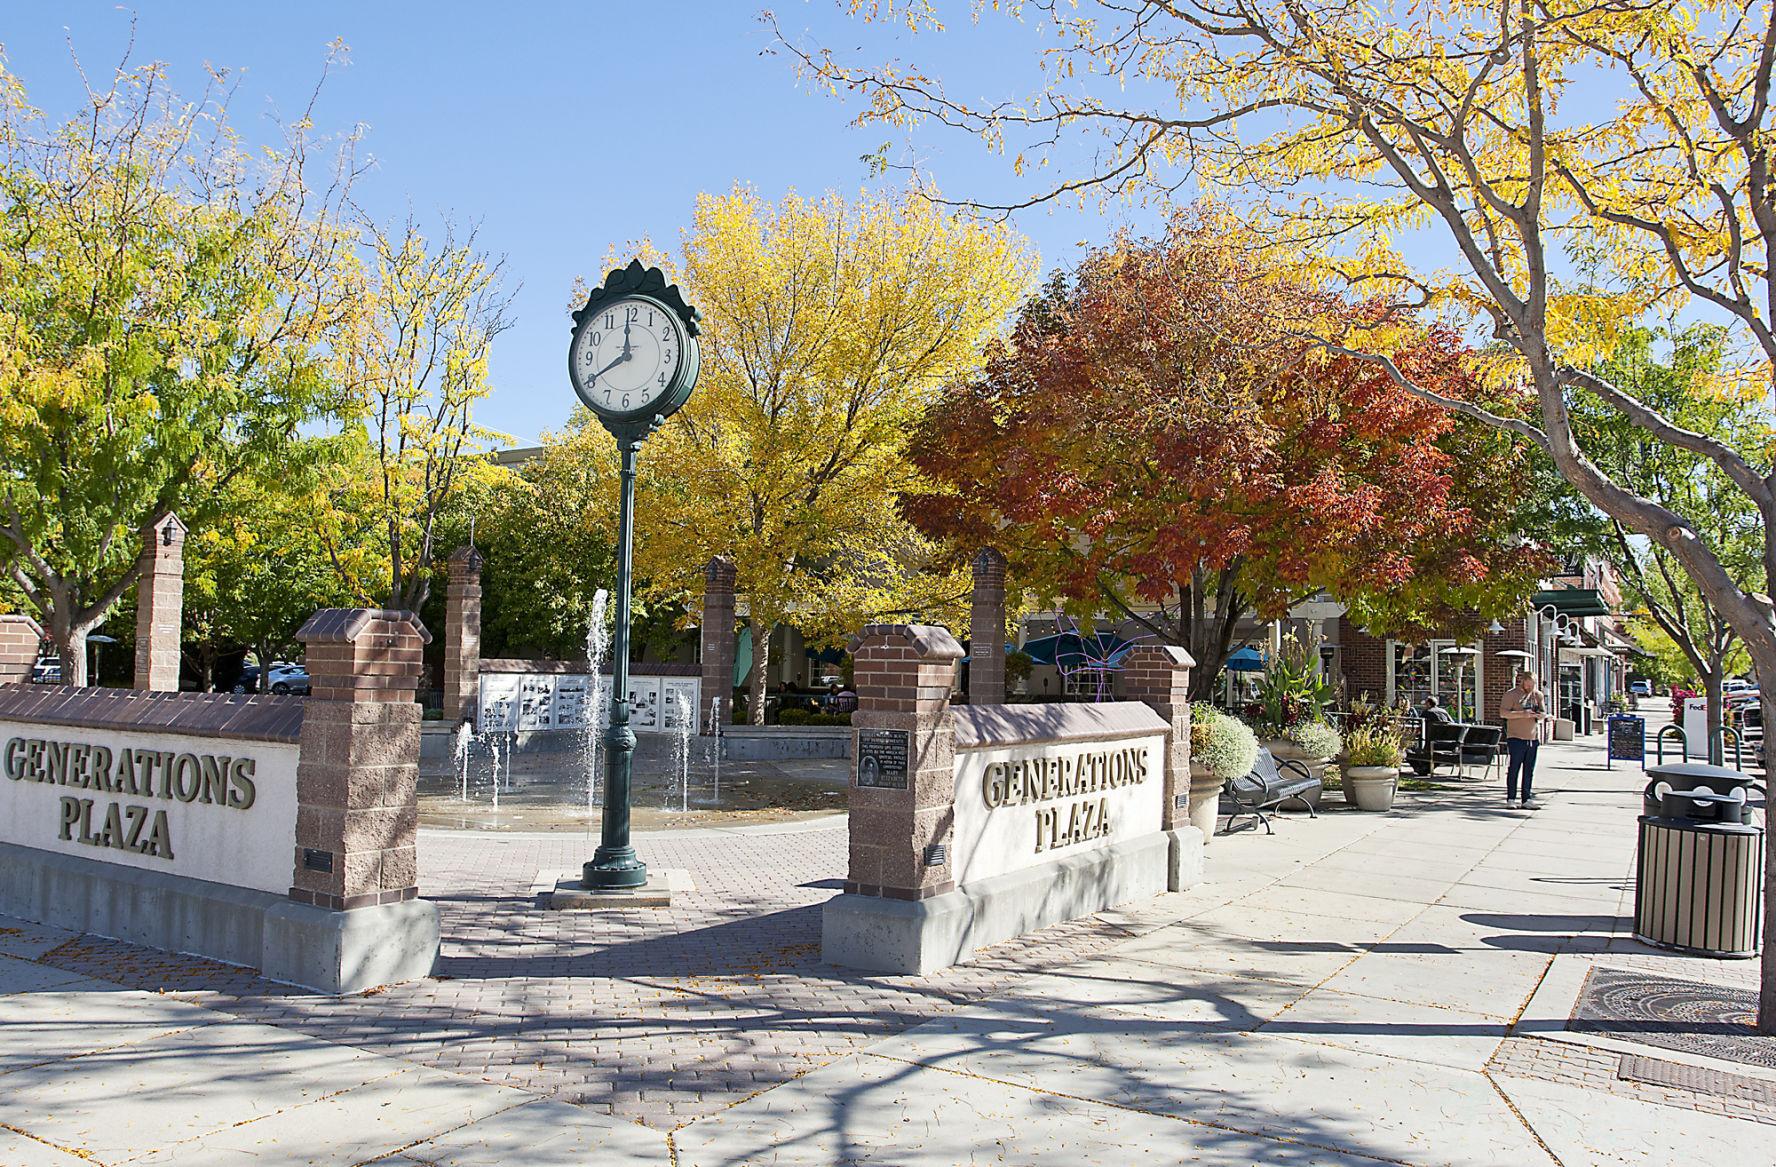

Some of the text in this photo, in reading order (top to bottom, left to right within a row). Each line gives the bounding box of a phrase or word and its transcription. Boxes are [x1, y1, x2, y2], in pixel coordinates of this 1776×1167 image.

[604, 314, 614, 329] 11
[626, 308, 638, 322] 12
[648, 312, 653, 327] 1
[589, 331, 601, 346] 10
[663, 326, 670, 341] 2
[585, 351, 593, 366] 9
[664, 349, 671, 364] 3
[587, 373, 596, 388] 8
[657, 371, 666, 387] 4
[603, 389, 611, 404] 7
[622, 393, 630, 408] 6
[641, 388, 650, 404] 5
[3, 737, 256, 810] GENERATIONS
[982, 745, 1149, 811] GENERATIONS
[58, 796, 175, 860] PLAZA
[1034, 797, 1114, 854] PLAZA
